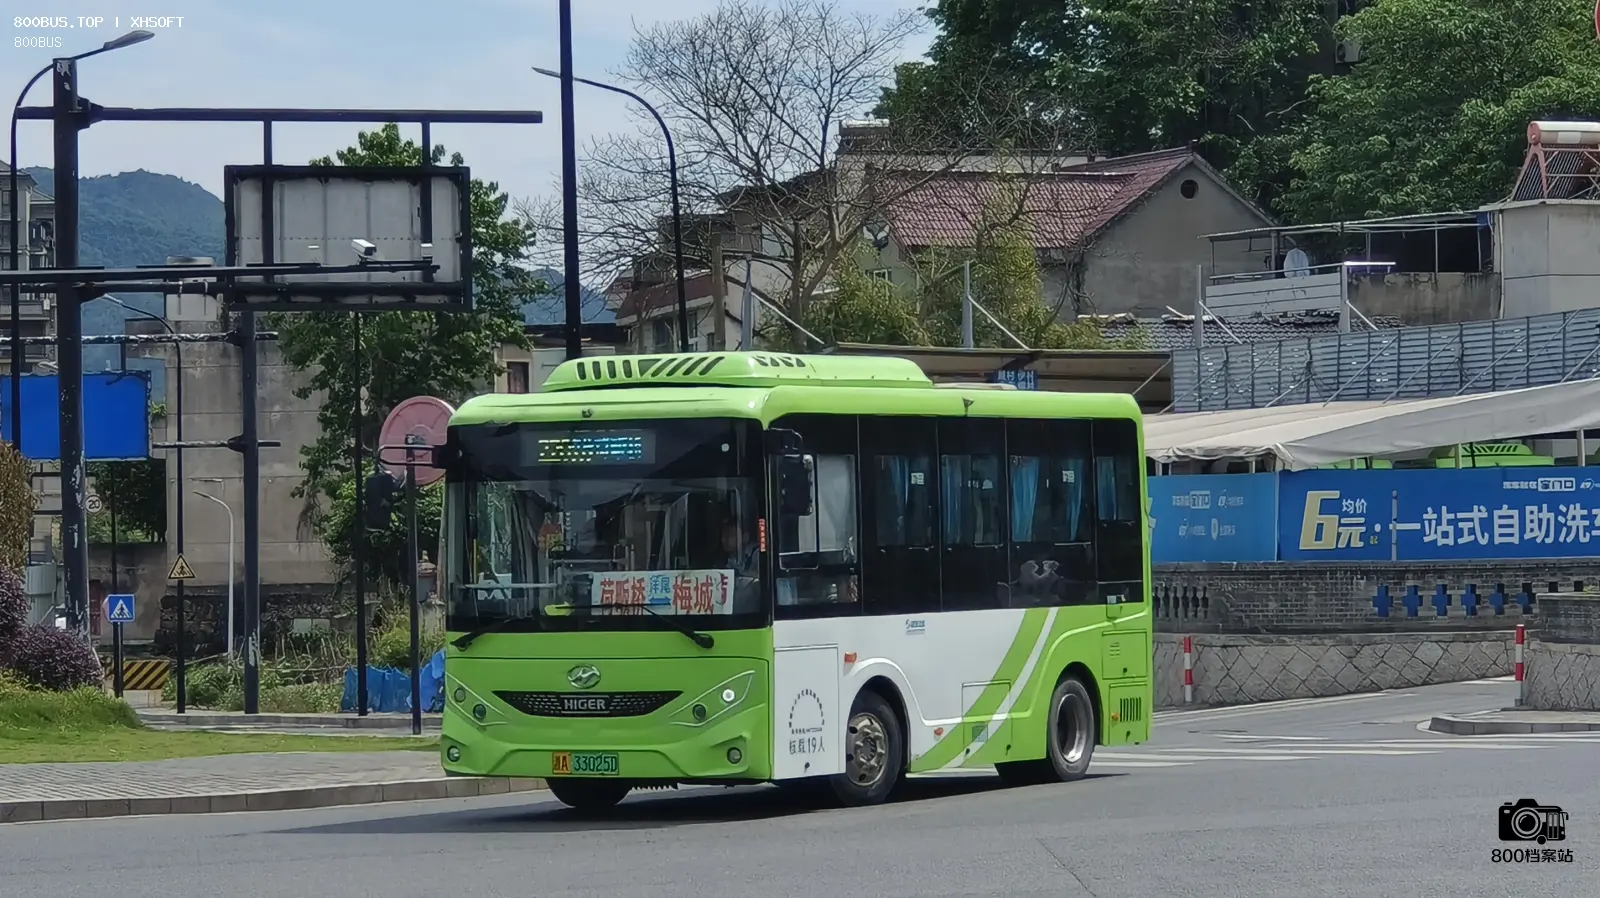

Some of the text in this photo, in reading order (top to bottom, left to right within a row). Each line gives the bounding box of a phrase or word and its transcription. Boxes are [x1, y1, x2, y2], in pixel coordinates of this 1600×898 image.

[88, 499, 100, 509] 20
[1341, 498, 1367, 514] 均价
[1299, 490, 1366, 550] 6元
[672, 575, 713, 614] 梅城
[564, 699, 606, 710] HIGER
